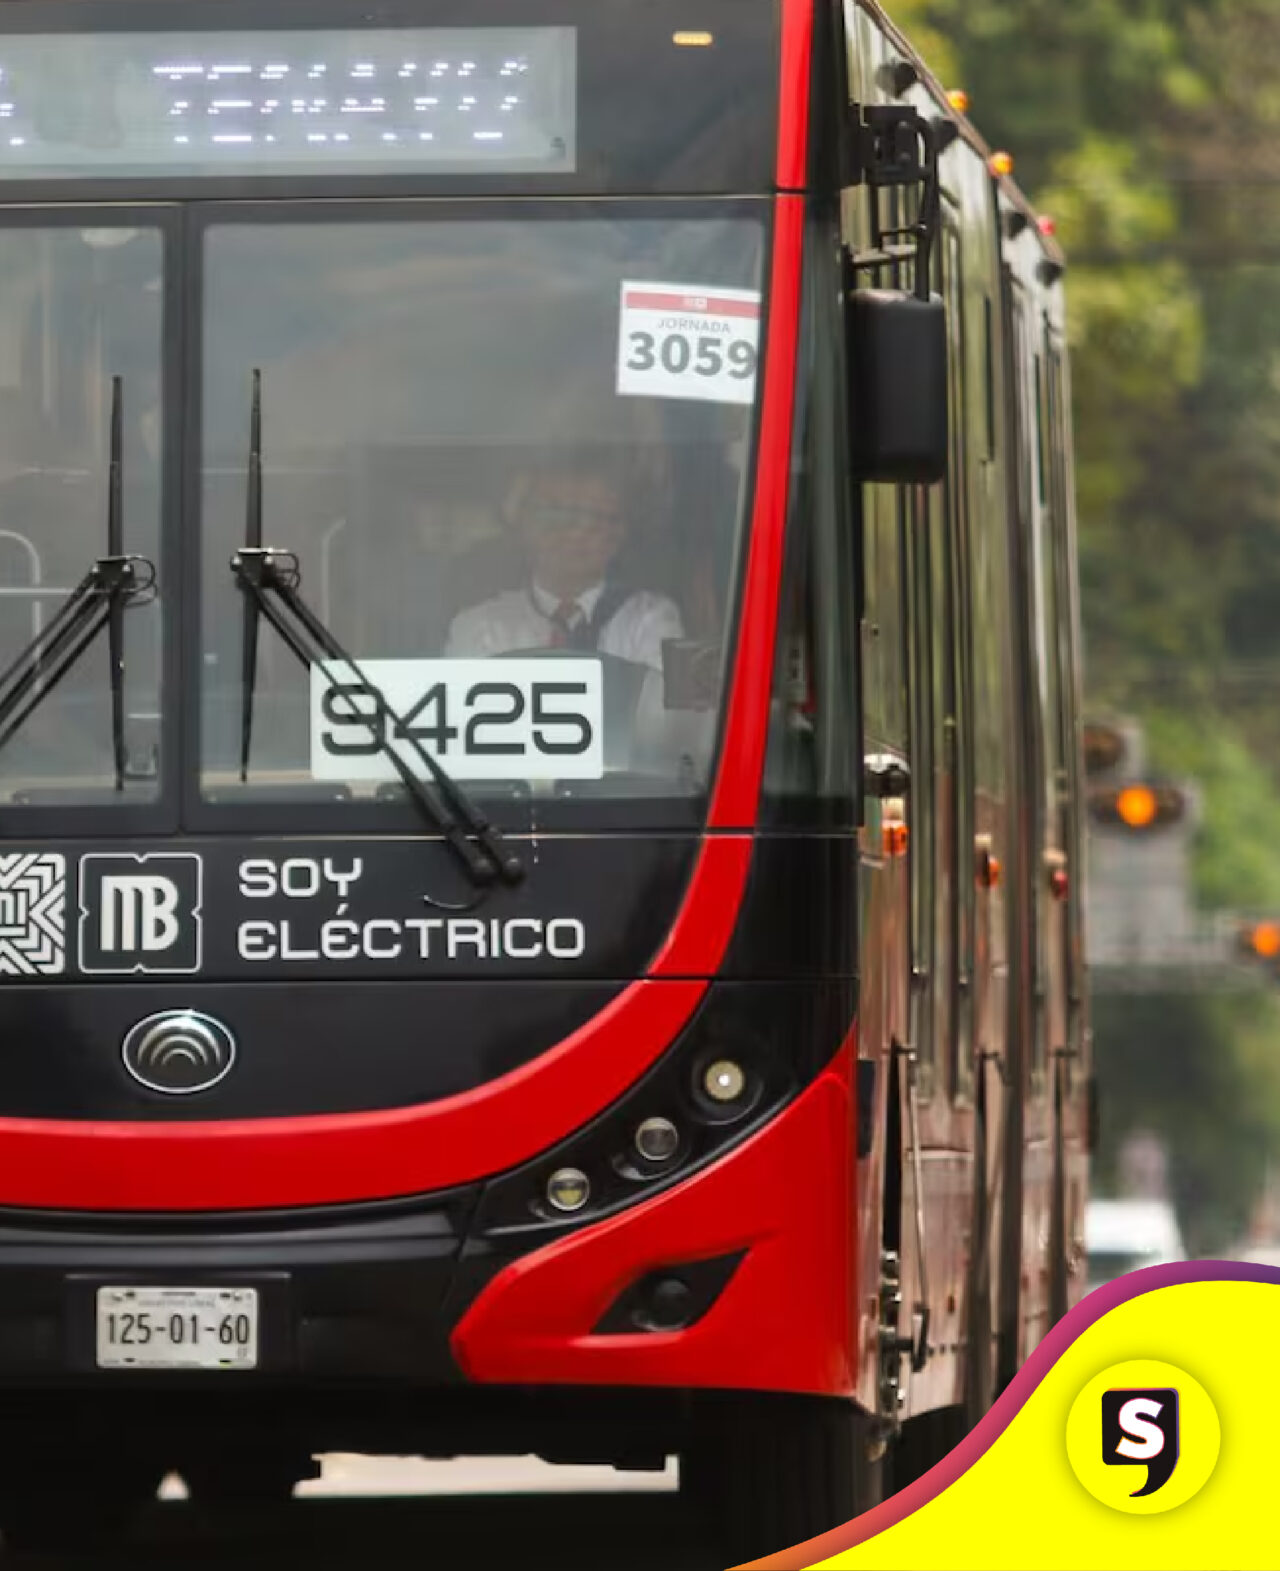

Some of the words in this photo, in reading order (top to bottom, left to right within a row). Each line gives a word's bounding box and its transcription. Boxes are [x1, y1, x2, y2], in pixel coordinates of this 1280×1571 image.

[657, 318, 731, 333] JORNADA
[626, 331, 756, 380] 3059
[321, 681, 593, 756] 9425
[237, 857, 363, 899] SOY
[236, 903, 586, 961] ELÉCTRICO
[107, 1313, 250, 1344] 125-01-60
